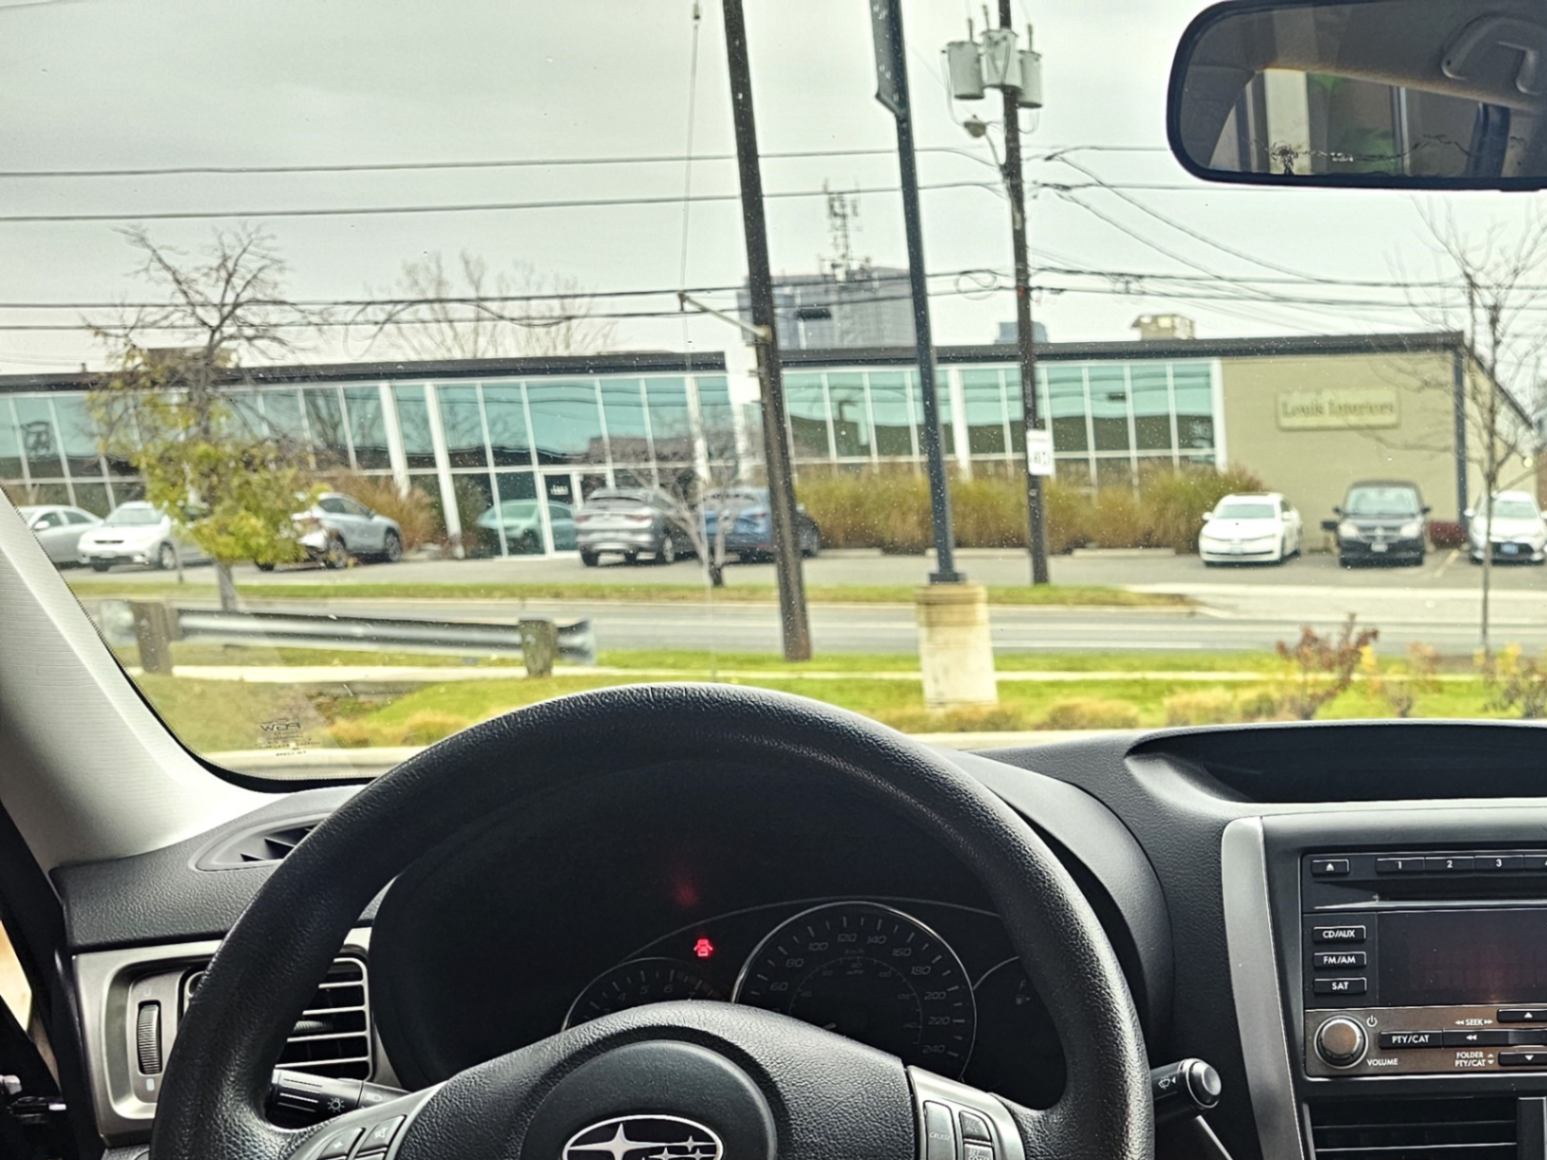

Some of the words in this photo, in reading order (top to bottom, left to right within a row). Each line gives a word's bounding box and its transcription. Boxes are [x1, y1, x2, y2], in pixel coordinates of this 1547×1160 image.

[1322, 929, 1356, 939] CD/AUX
[1323, 955, 1356, 964] FM/AM
[1332, 981, 1349, 990] SAT
[1465, 1018, 1484, 1026] SEEK
[1391, 1034, 1430, 1043] PTY/CAT
[1456, 1051, 1483, 1059] FOLDER
[1367, 1058, 1399, 1066] VOLUME
